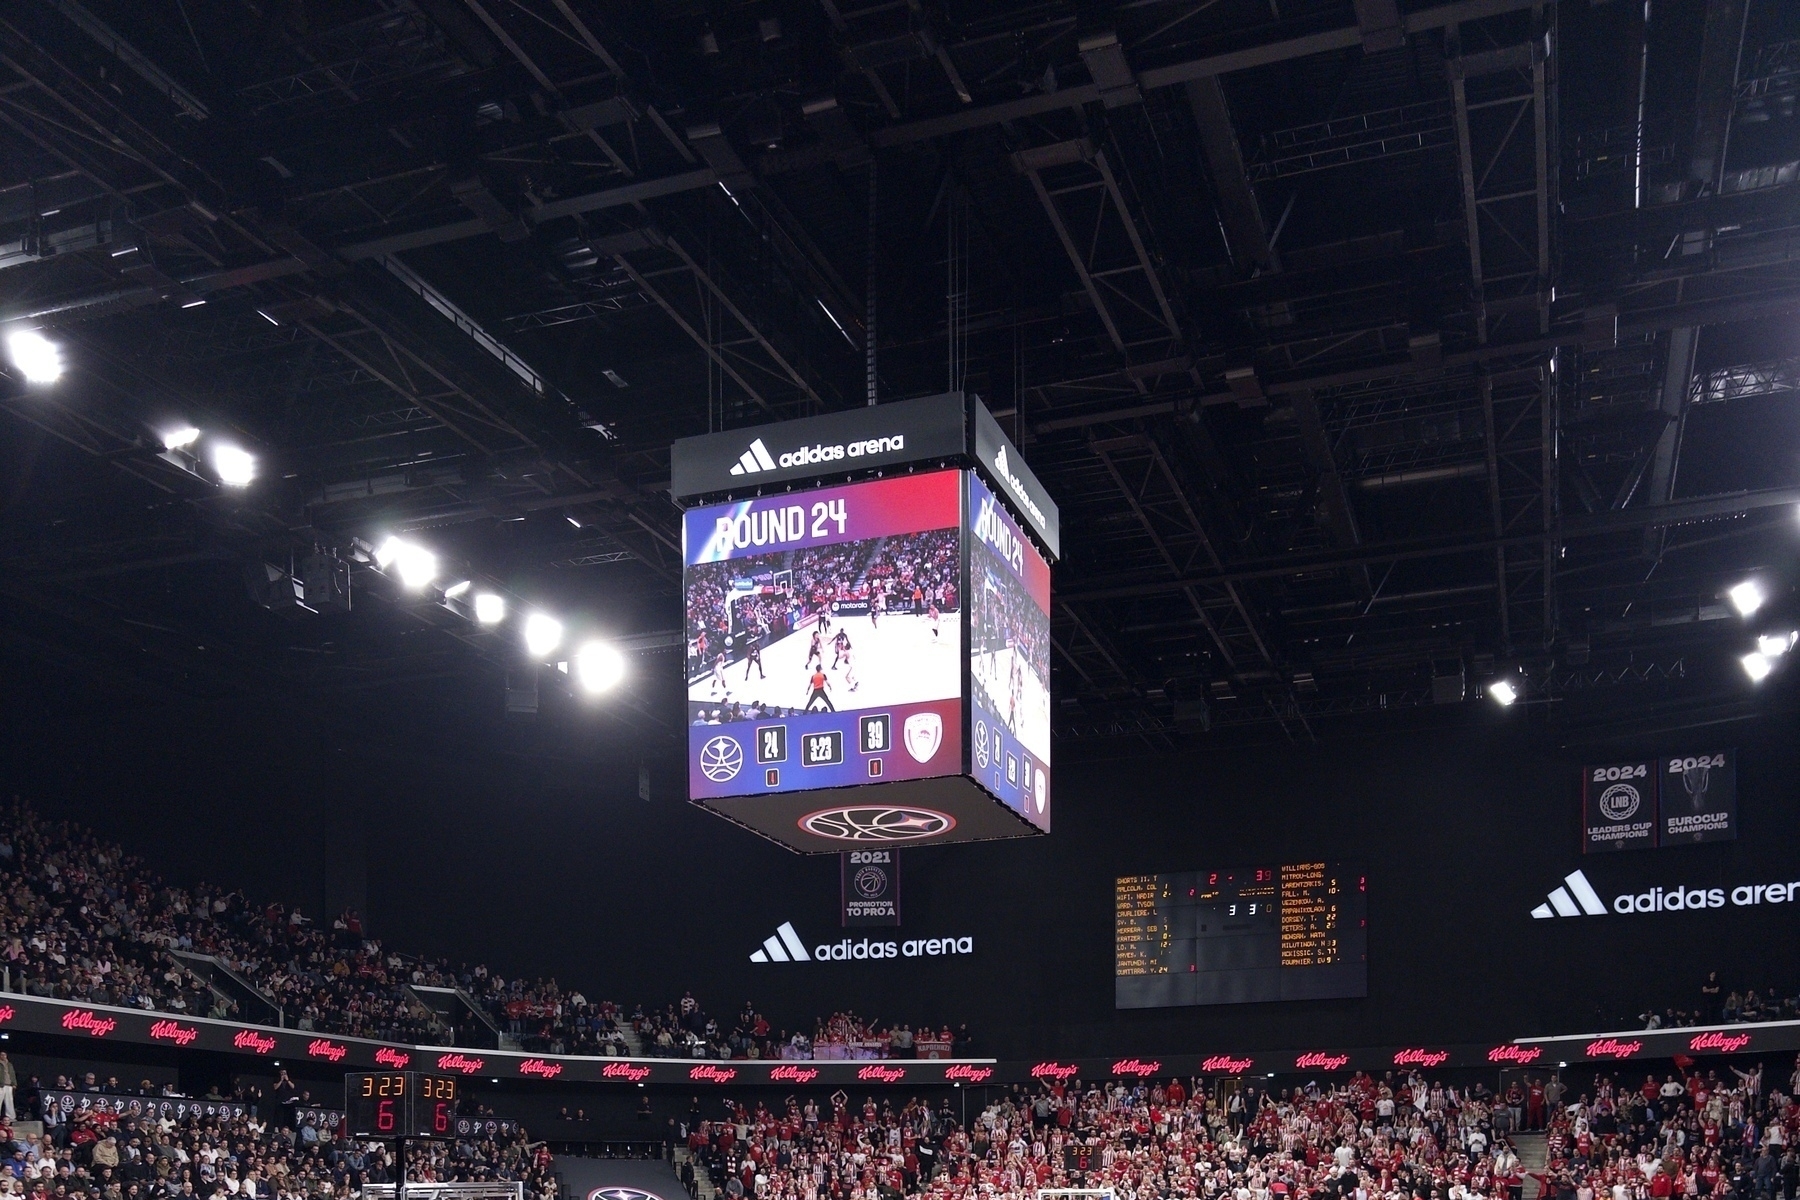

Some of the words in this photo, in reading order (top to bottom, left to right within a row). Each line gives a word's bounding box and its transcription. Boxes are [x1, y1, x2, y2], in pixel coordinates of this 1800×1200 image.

[779, 445, 845, 469] adidas
[847, 434, 904, 457] arena
[1009, 474, 1030, 508] adidas
[716, 506, 804, 552] ROUND
[811, 499, 847, 538] 24
[981, 498, 1012, 562] ROUND
[1011, 536, 1023, 577] 24
[867, 721, 881, 749] 39
[765, 731, 779, 759] 24
[1669, 753, 1725, 774] 2024
[1593, 764, 1647, 782] 2024
[1611, 796, 1629, 810] LNB
[1668, 812, 1728, 827] EUROCUP
[1668, 821, 1728, 835] CHAMPIONS
[1588, 823, 1630, 835] LEADERS
[1632, 822, 1652, 832] CUP
[1591, 830, 1648, 842] CHAMPIONS
[850, 851, 891, 864] 2021
[1614, 885, 1725, 914] adidas
[846, 908, 861, 916] TO
[863, 907, 885, 916] PRO
[887, 907, 895, 916] A
[815, 938, 897, 961] adidas
[902, 936, 973, 957] arena
[63, 1010, 115, 1035] Kellogg's
[151, 1021, 196, 1044] Kellogg's
[235, 1031, 275, 1053] Kellogg's
[309, 1040, 345, 1061] Kellogg's
[1587, 1040, 1640, 1057] Kellogg's
[1691, 1033, 1748, 1051] Kellogg's
[376, 1048, 408, 1068] Kellogg's
[1297, 1053, 1347, 1069] Kellogg's
[1395, 1049, 1447, 1066] Kellogg's
[1489, 1046, 1540, 1063] Kellogg's
[439, 1055, 482, 1073] Kellogg's
[521, 1060, 561, 1077] Kellogg's
[604, 1064, 649, 1080] Kellogg's
[1032, 1063, 1077, 1078] Kellogg's
[1113, 1060, 1159, 1075] Kellogg's
[1203, 1057, 1251, 1073] Kellogg's
[691, 1066, 735, 1082] Kellogg's
[771, 1066, 817, 1082] Kellogg's
[859, 1066, 904, 1081] Kellogg's
[946, 1066, 991, 1081] Kellogg's
[378, 1100, 394, 1130] 6
[435, 1103, 447, 1131] 6
